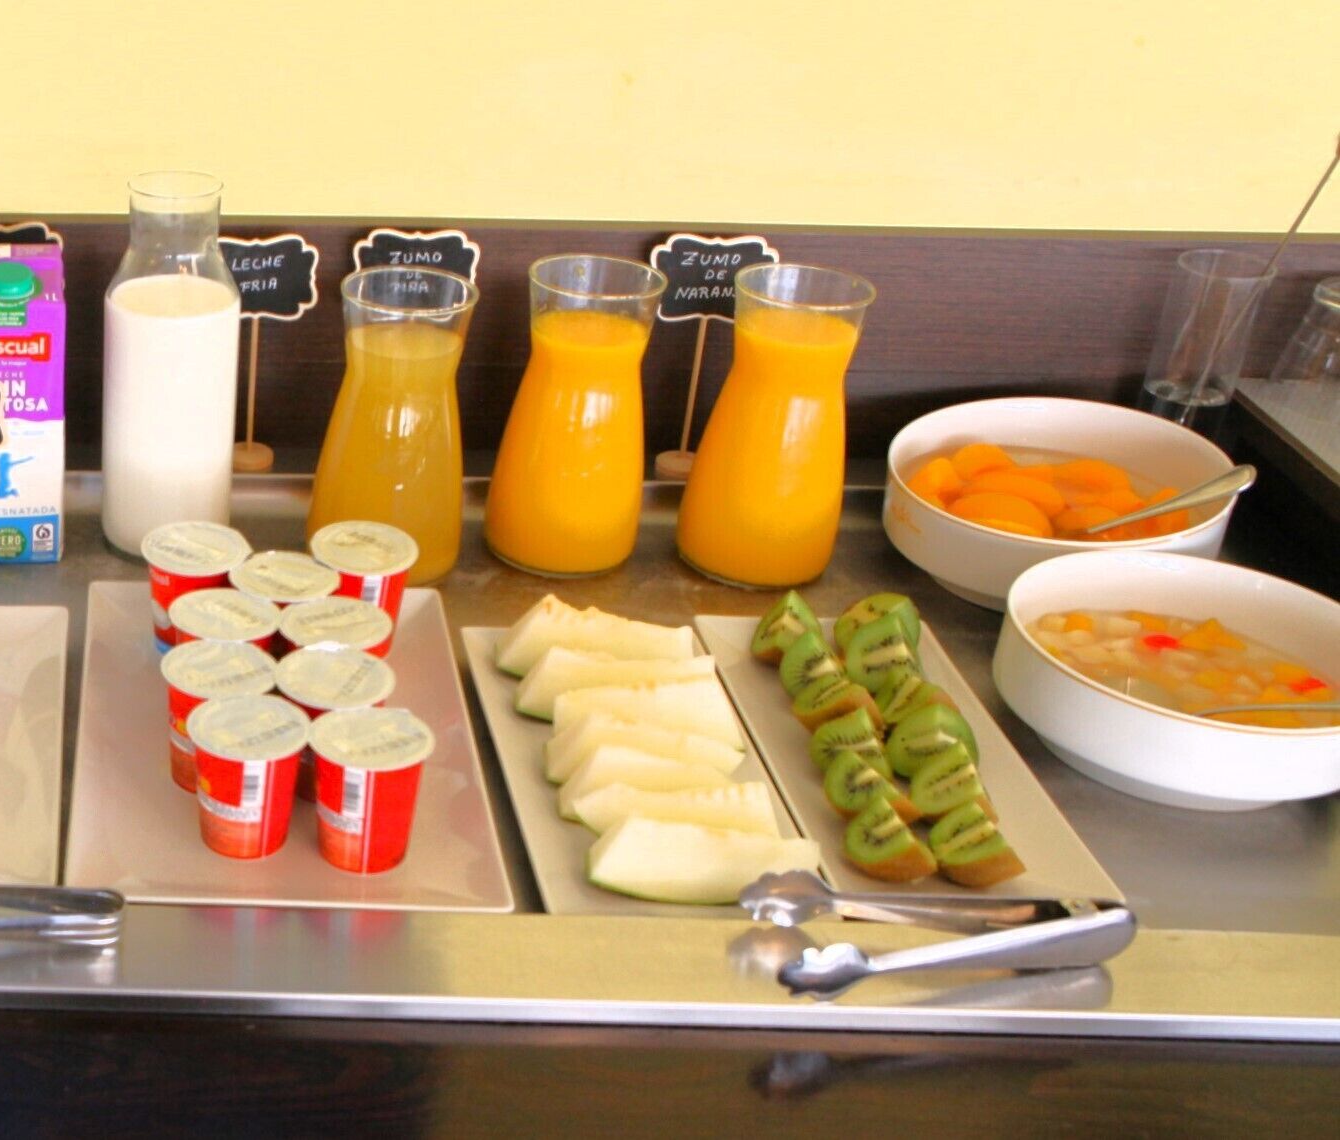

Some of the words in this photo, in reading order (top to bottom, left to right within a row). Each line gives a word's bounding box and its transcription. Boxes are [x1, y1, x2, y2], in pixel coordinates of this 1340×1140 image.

[231, 254, 285, 272] LECHE
[389, 251, 443, 265] ZUMO
[681, 251, 742, 266] ZUMO
[704, 269, 728, 281] DE
[240, 277, 278, 293] FRIA
[675, 286, 736, 300] NARAN
[3, 379, 27, 397] IN
[4, 397, 49, 412] TOSA
